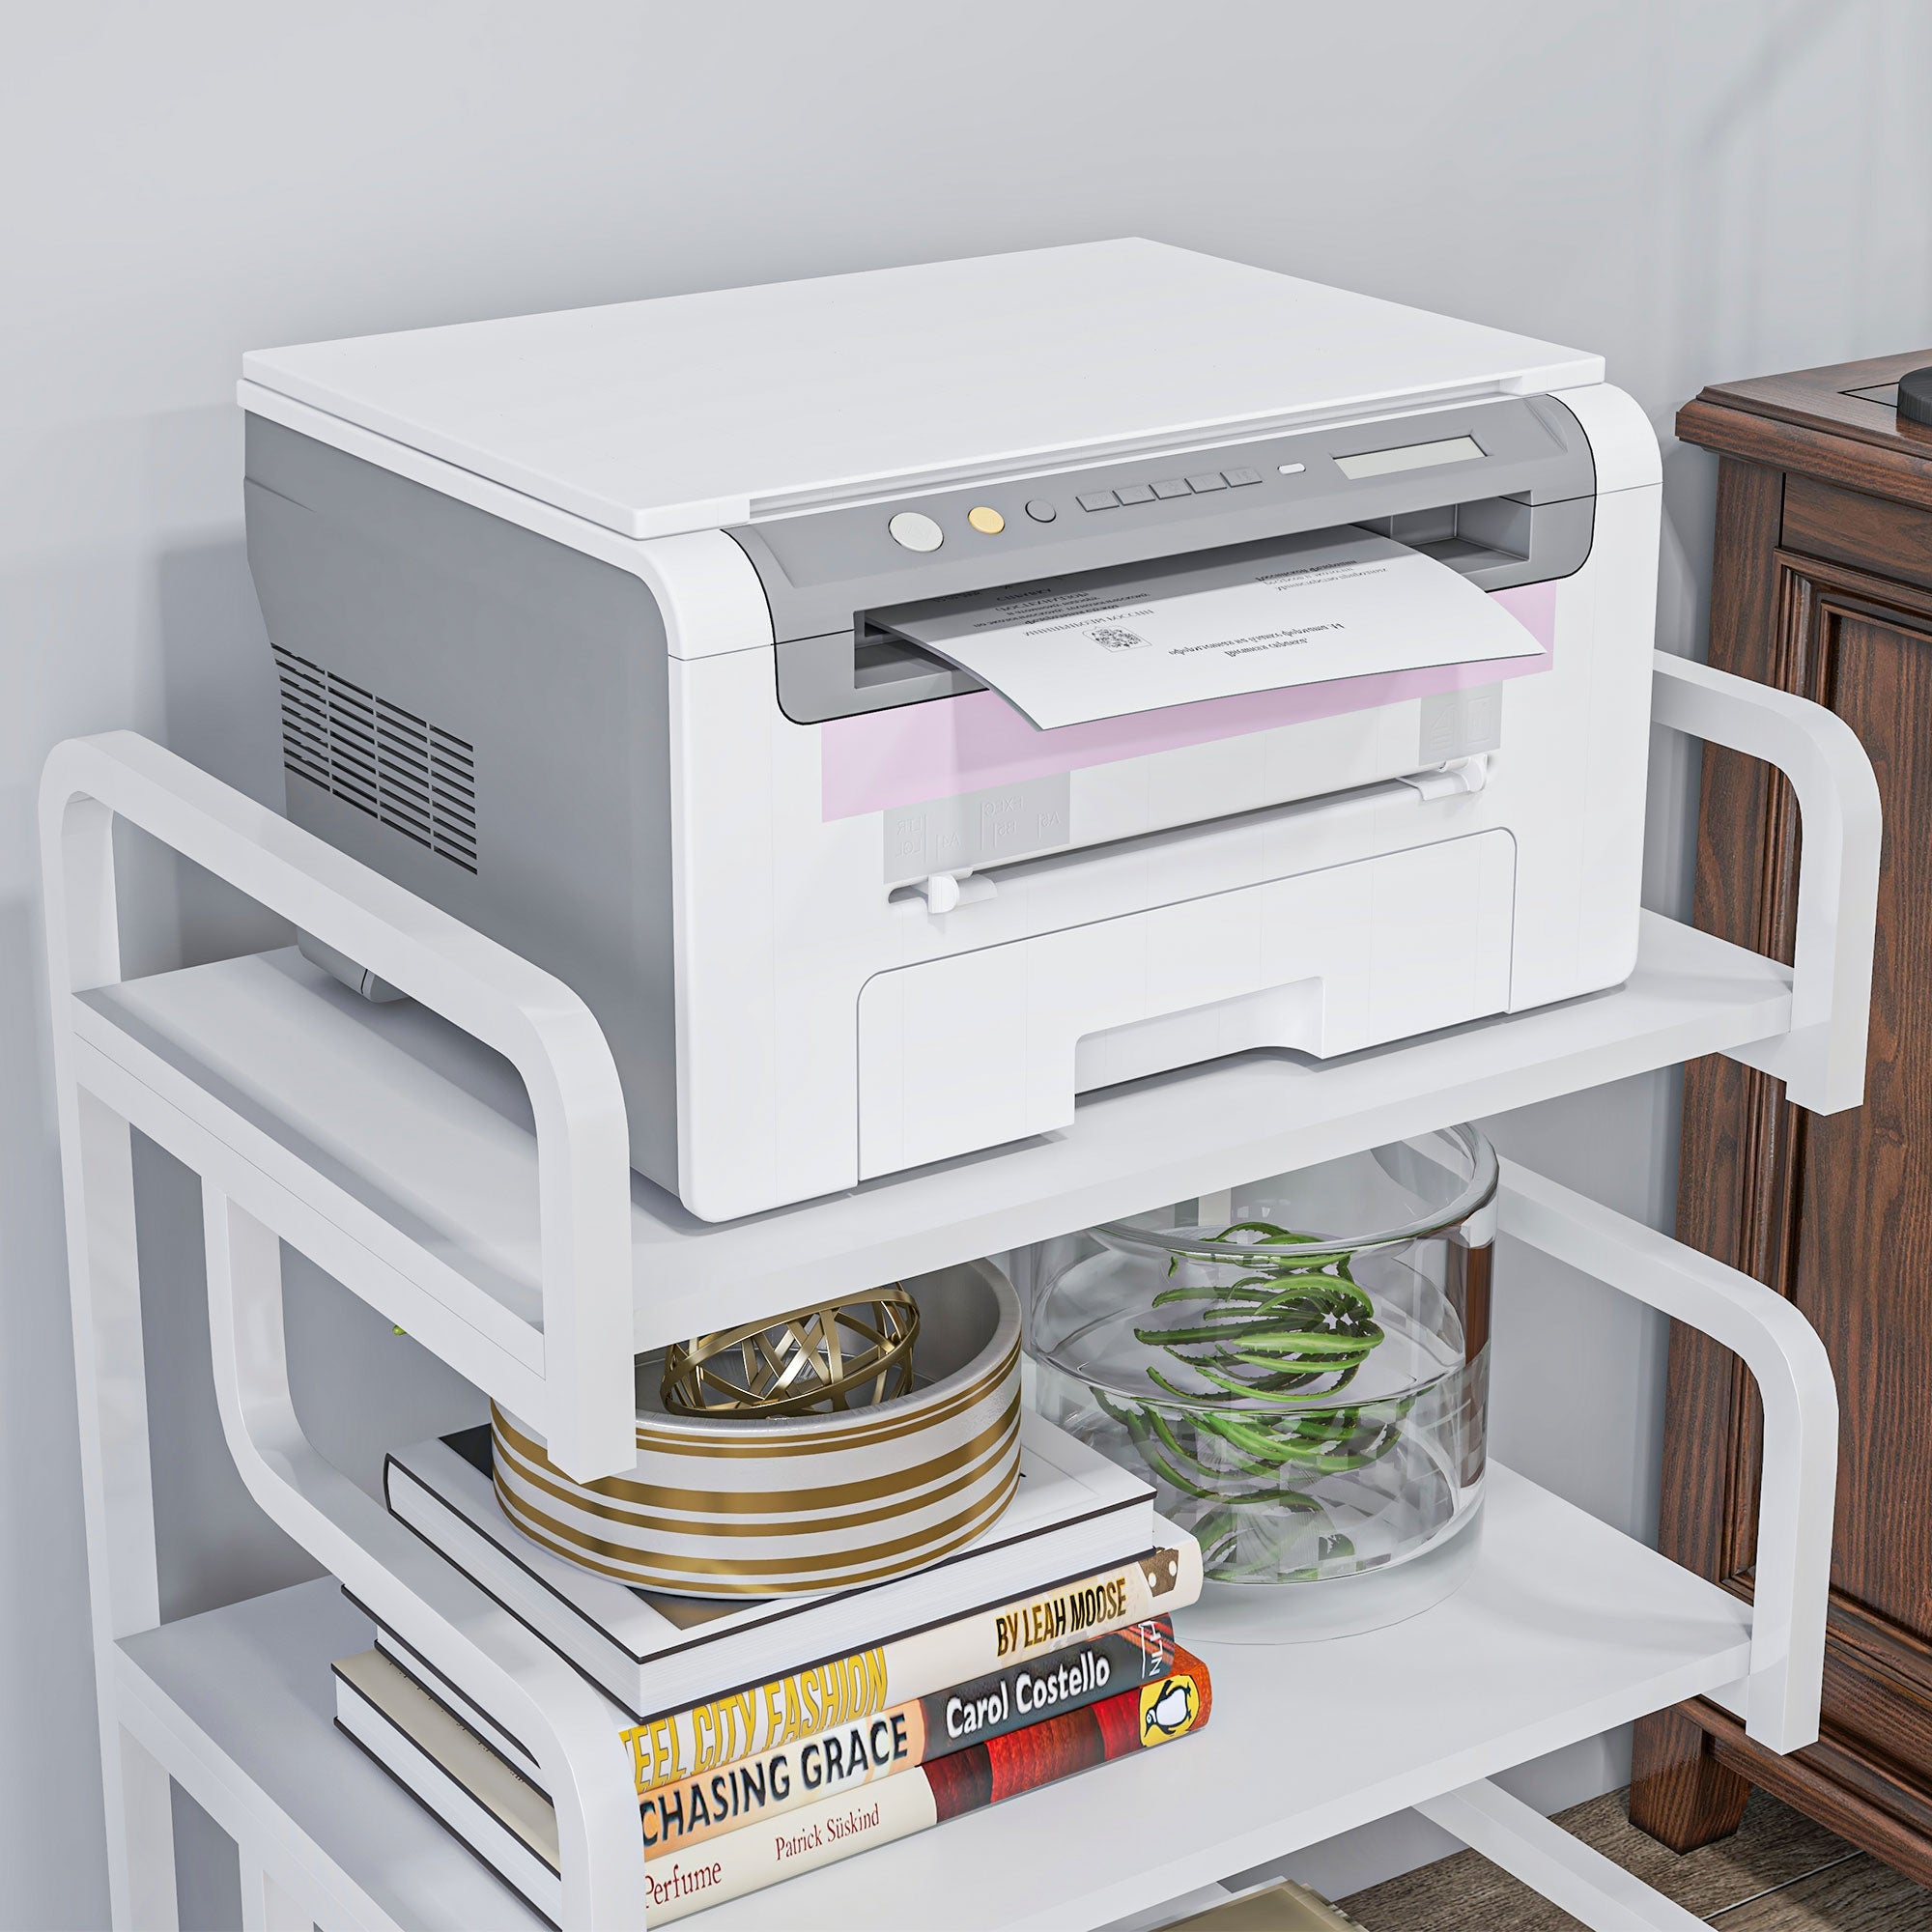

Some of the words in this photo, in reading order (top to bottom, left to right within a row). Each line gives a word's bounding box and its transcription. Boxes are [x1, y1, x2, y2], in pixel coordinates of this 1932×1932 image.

[995, 1611, 1019, 1658] BY
[1022, 1598, 1066, 1648] LEAH
[1068, 1577, 1127, 1634] MOOSE
[690, 1689, 756, 1776] CITY
[761, 1646, 888, 1751] FASHION
[946, 1679, 1009, 1739] Carol
[1015, 1650, 1111, 1715] Costello
[639, 1754, 791, 1847] CHASING
[800, 1714, 909, 1790] GRACE
[775, 1824, 823, 1861] Patrick
[826, 1803, 880, 1843] Süskind
